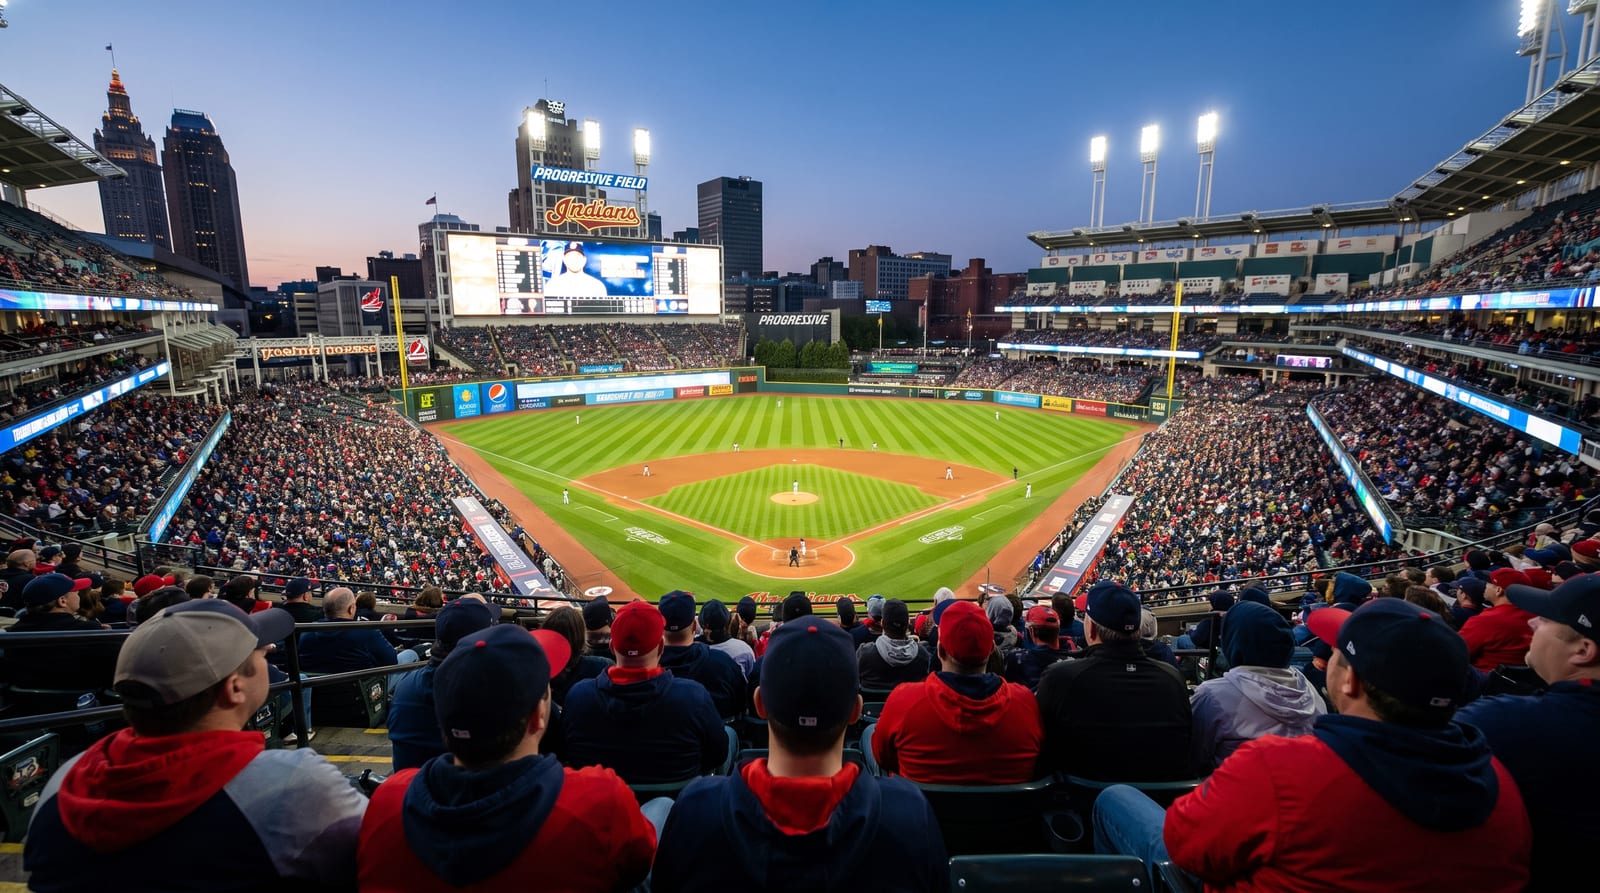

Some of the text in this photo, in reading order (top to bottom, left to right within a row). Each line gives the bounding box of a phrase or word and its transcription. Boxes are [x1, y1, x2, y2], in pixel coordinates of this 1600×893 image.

[534, 167, 646, 189] PROGRESSIVE FIELD
[545, 196, 641, 231] Indians
[758, 314, 830, 326] PROGRESSIVE
